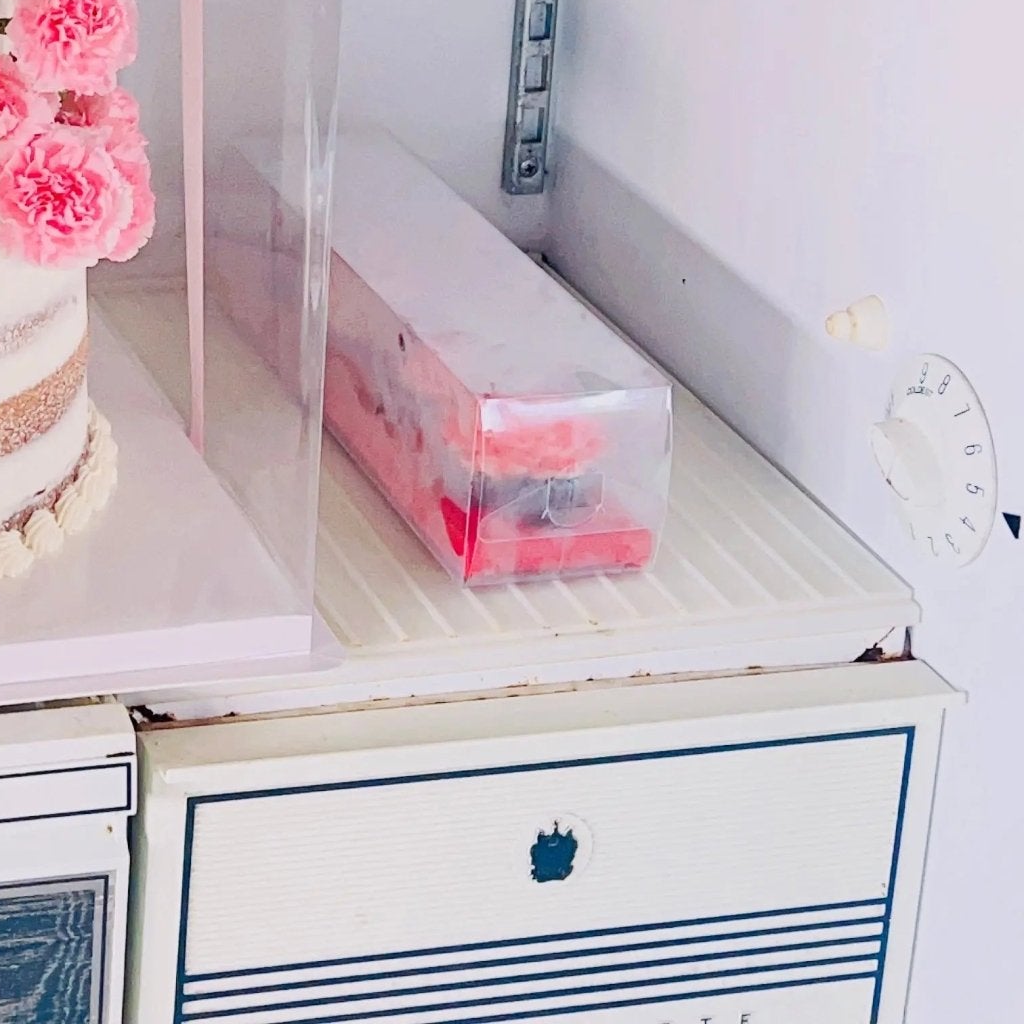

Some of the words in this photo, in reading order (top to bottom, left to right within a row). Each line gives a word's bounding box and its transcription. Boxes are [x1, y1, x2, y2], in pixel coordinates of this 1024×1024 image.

[937, 374, 951, 395] 8
[953, 402, 971, 417] 7
[964, 443, 983, 456] 6
[966, 482, 985, 498] 5
[958, 516, 976, 532] 4
[927, 536, 939, 557] 2
[944, 533, 961, 554] 3
